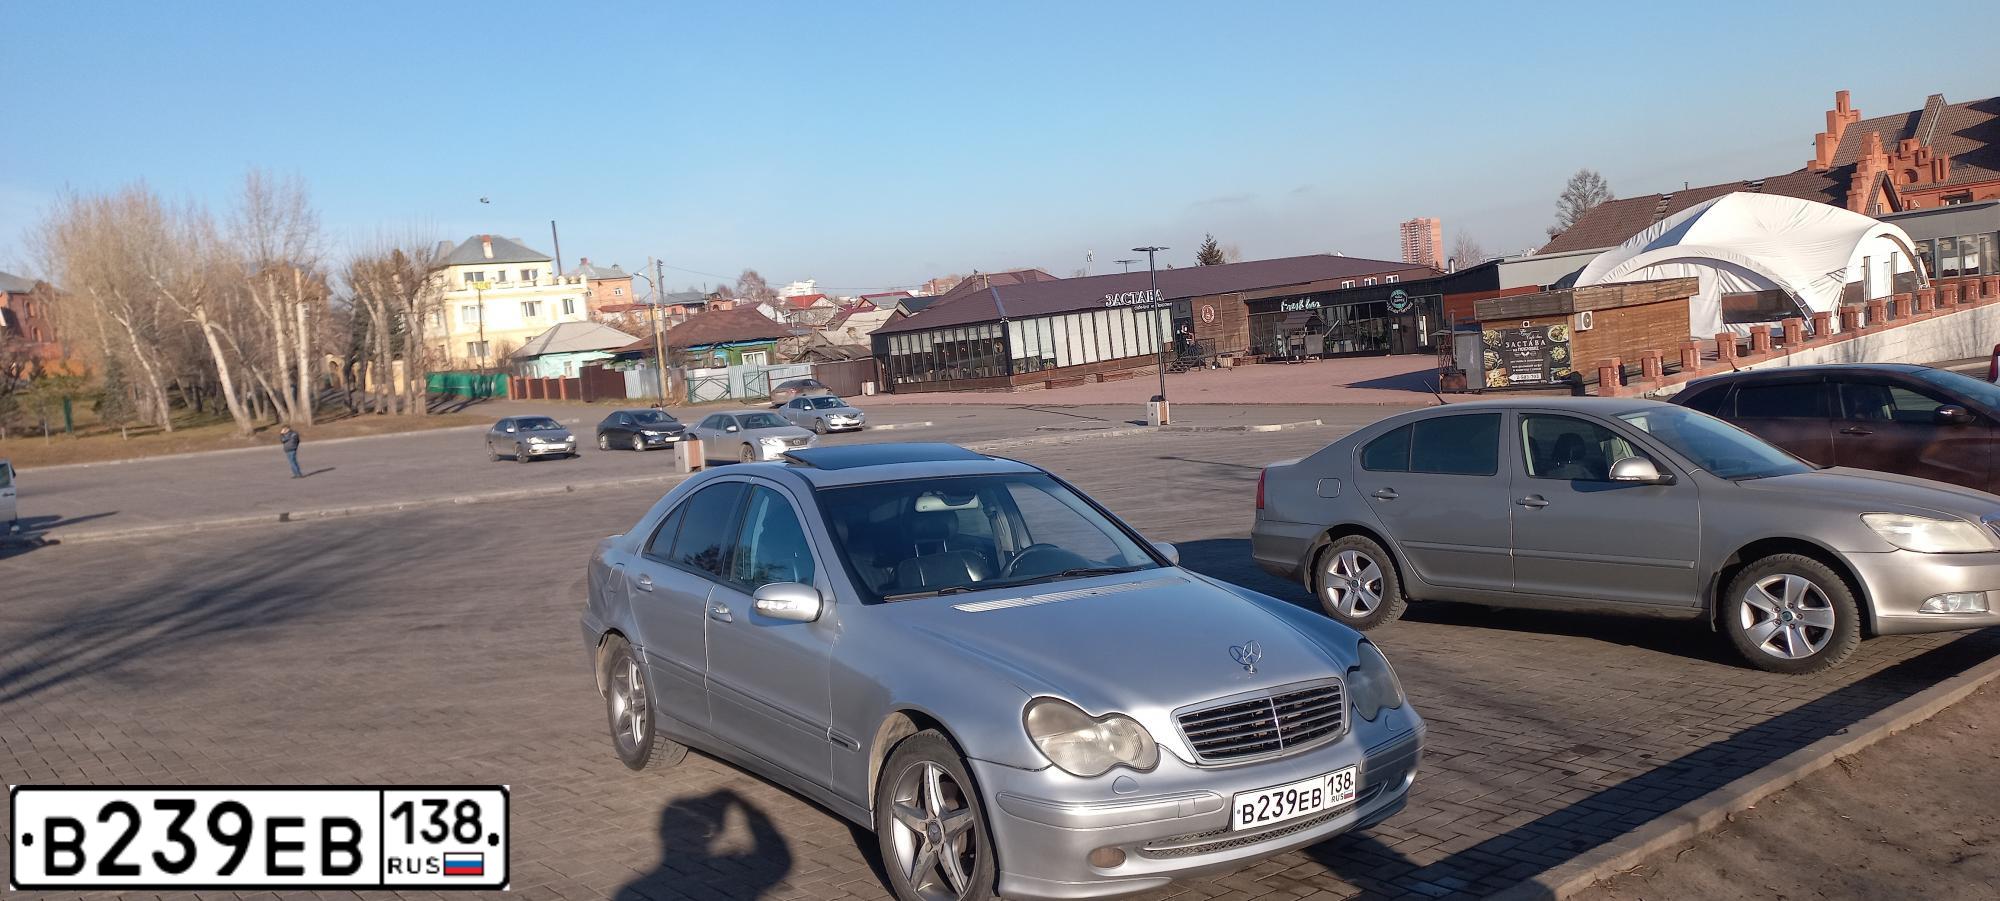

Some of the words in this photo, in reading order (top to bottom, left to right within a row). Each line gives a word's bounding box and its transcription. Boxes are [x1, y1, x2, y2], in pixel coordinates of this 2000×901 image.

[1105, 289, 1165, 307] ЗАСТАВА
[1505, 339, 1546, 348] ЗАСТАВА
[1326, 771, 1352, 796] 138
[1242, 787, 1322, 825] В239ЕВ
[1331, 792, 1345, 803] RUS
